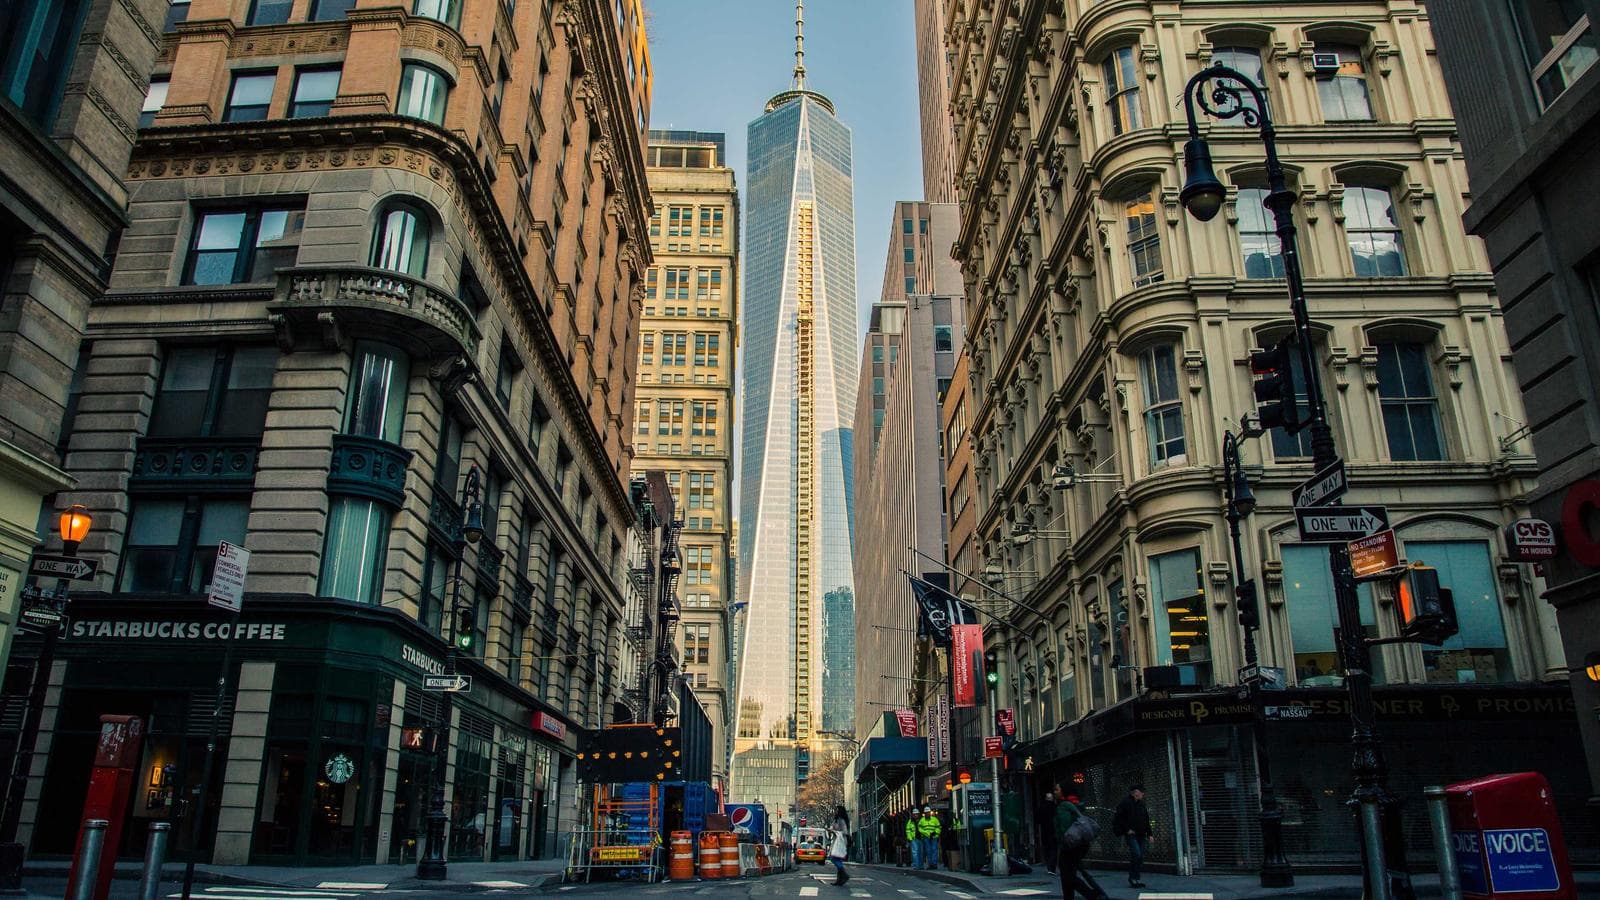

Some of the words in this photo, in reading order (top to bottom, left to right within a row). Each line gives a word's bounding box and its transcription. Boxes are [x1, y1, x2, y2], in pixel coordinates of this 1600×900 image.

[1300, 488, 1316, 507] ONE
[1321, 472, 1339, 495] WAY
[1311, 518, 1337, 531] ONE
[1347, 517, 1375, 531] WAY
[1516, 523, 1550, 536] CVS
[220, 543, 227, 556] 3
[1350, 543, 1359, 551] NO
[1359, 535, 1387, 549] STANDING
[39, 561, 58, 571] ONE
[65, 563, 88, 575] WAY
[73, 620, 201, 639] STARBUCKS
[203, 622, 286, 640] COFFEE
[402, 643, 442, 677] STARBUCKS
[430, 679, 445, 687] ONE
[1280, 709, 1308, 718] NASSAU
[1289, 698, 1425, 715] ESINER
[1141, 709, 1185, 720] DESIGNER
[1453, 833, 1480, 853] OICE
[1490, 832, 1546, 854] VOICE
